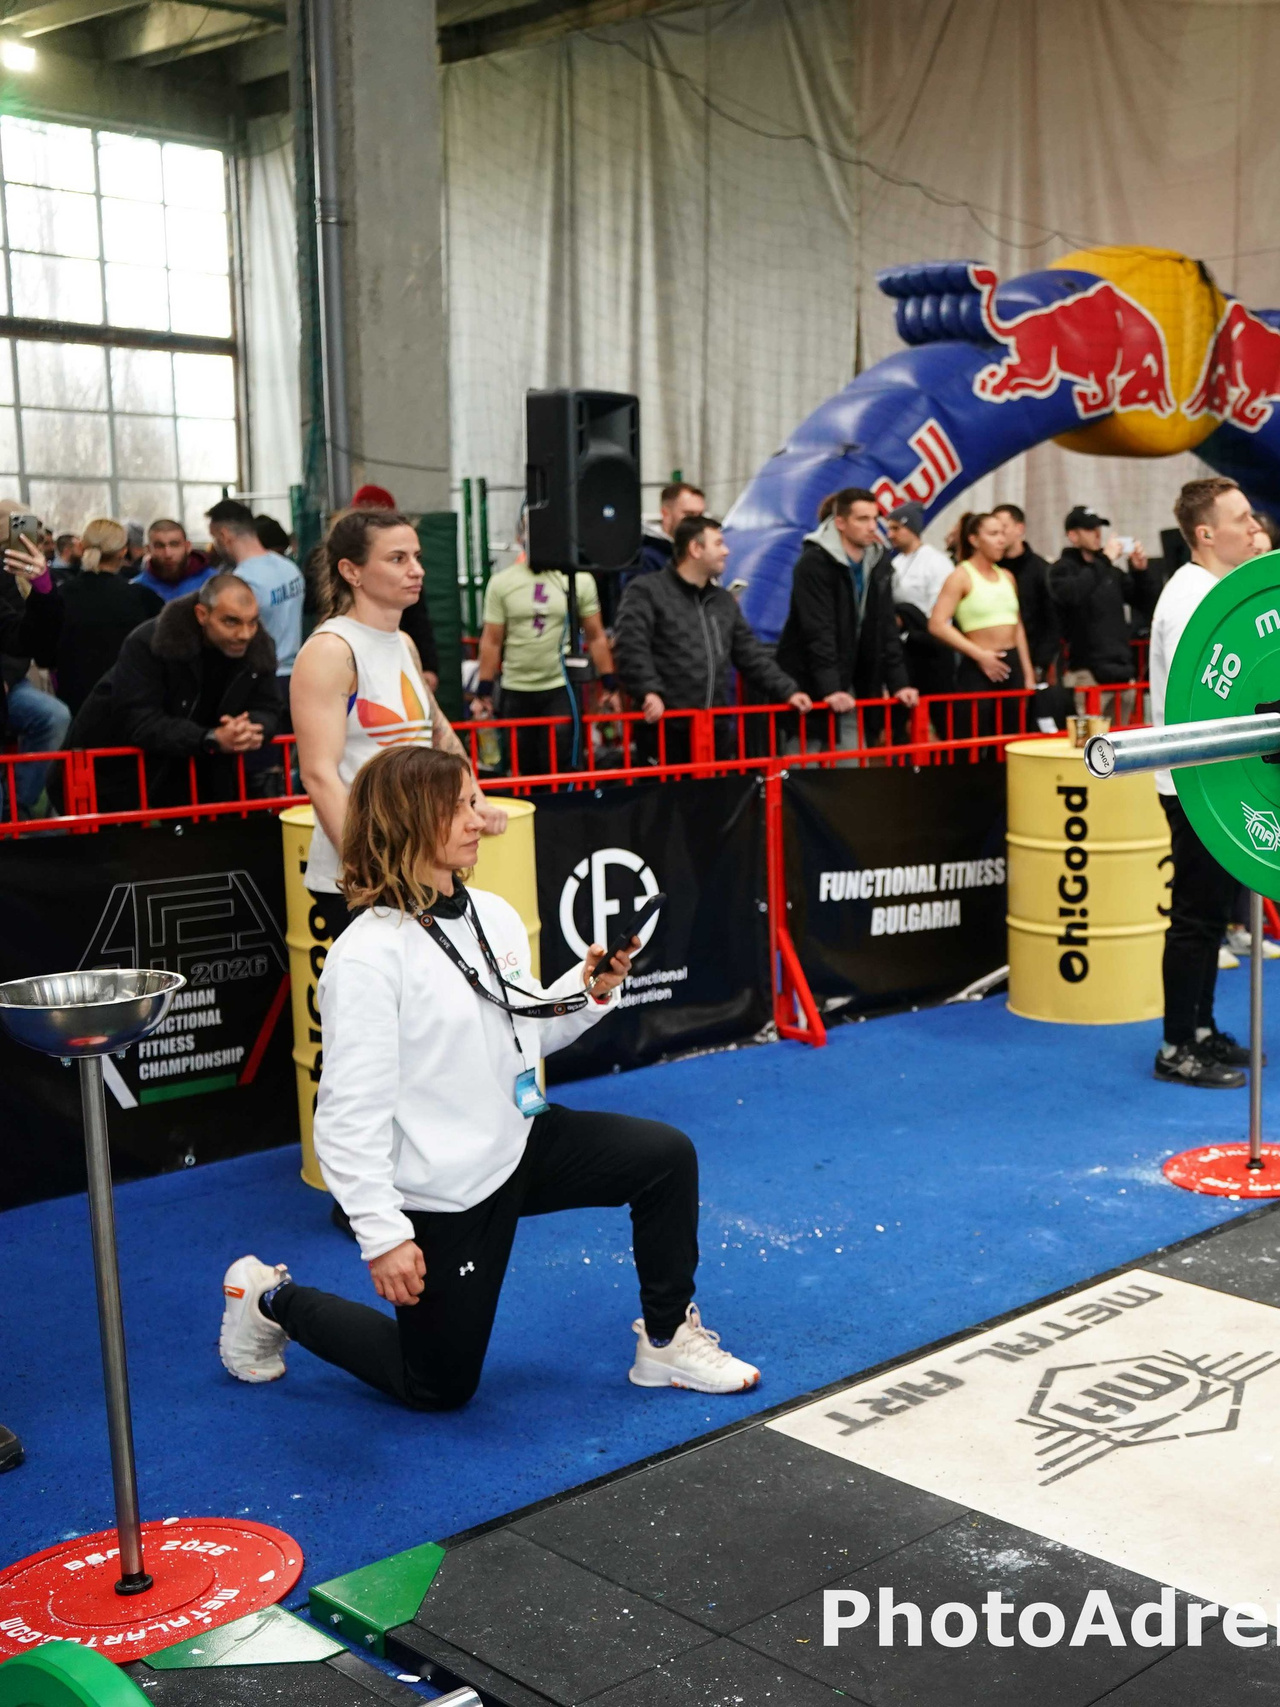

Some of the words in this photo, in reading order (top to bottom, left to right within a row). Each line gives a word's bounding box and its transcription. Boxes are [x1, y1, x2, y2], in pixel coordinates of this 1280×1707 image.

[872, 420, 961, 516] Bull
[1209, 643, 1242, 679] 10
[1201, 665, 1233, 700] KG
[1096, 745, 1110, 768] 20KG
[819, 863, 938, 903] FUNCTIONAL
[940, 857, 1006, 893] FITNESS
[1056, 785, 1090, 984] Oh!Good
[871, 899, 961, 937] BULGARIA
[191, 954, 268, 986] 2026
[625, 966, 688, 990] Functional
[171, 988, 216, 1011] ARIAN
[617, 987, 673, 1009] ederation
[149, 1008, 222, 1036] NCTIONAL
[138, 1034, 196, 1059] FITNESS
[138, 1046, 245, 1081] CHAMPIONSHIP
[954, 1285, 1164, 1365] METAL
[825, 1369, 965, 1437] ART
[160, 1540, 233, 1556] 2026
